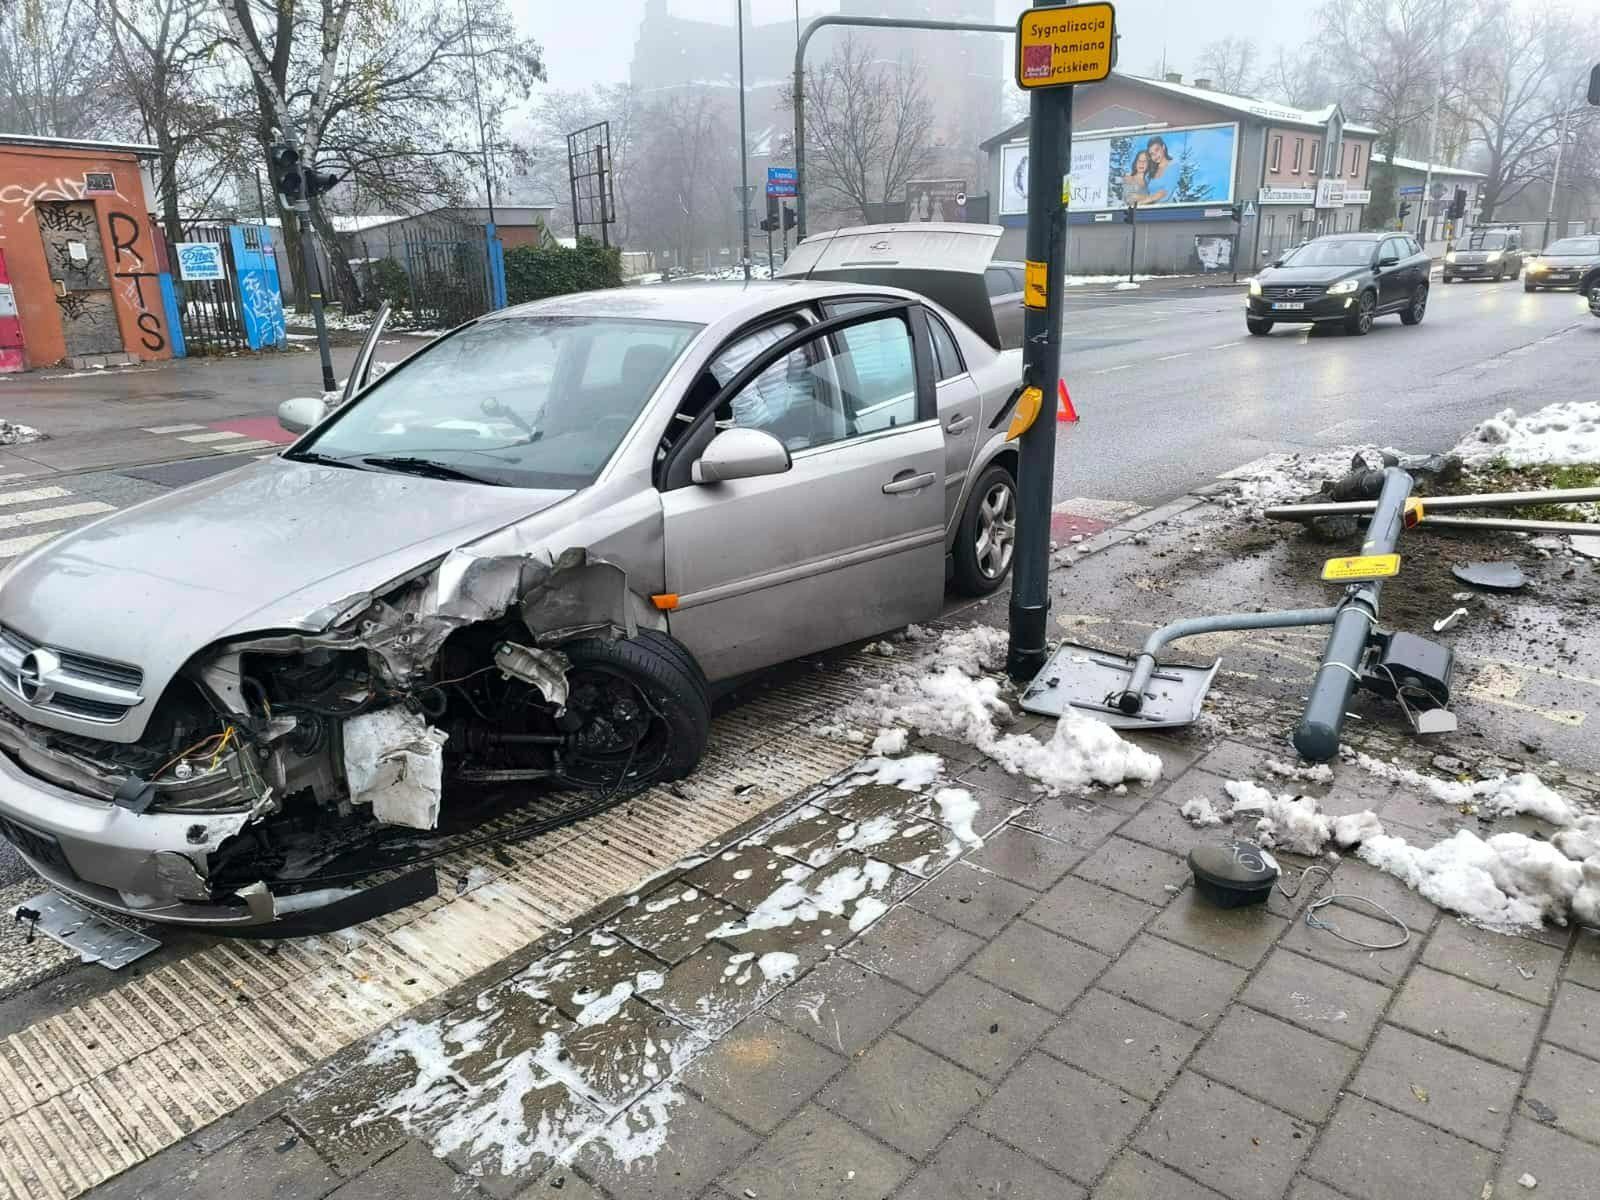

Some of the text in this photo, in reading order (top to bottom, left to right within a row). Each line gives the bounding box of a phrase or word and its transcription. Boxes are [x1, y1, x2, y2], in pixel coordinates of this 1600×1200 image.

[1031, 18, 1105, 38] Sygnalizacja
[1053, 41, 1105, 54] hamiana
[1051, 61, 1099, 77] yciskiem
